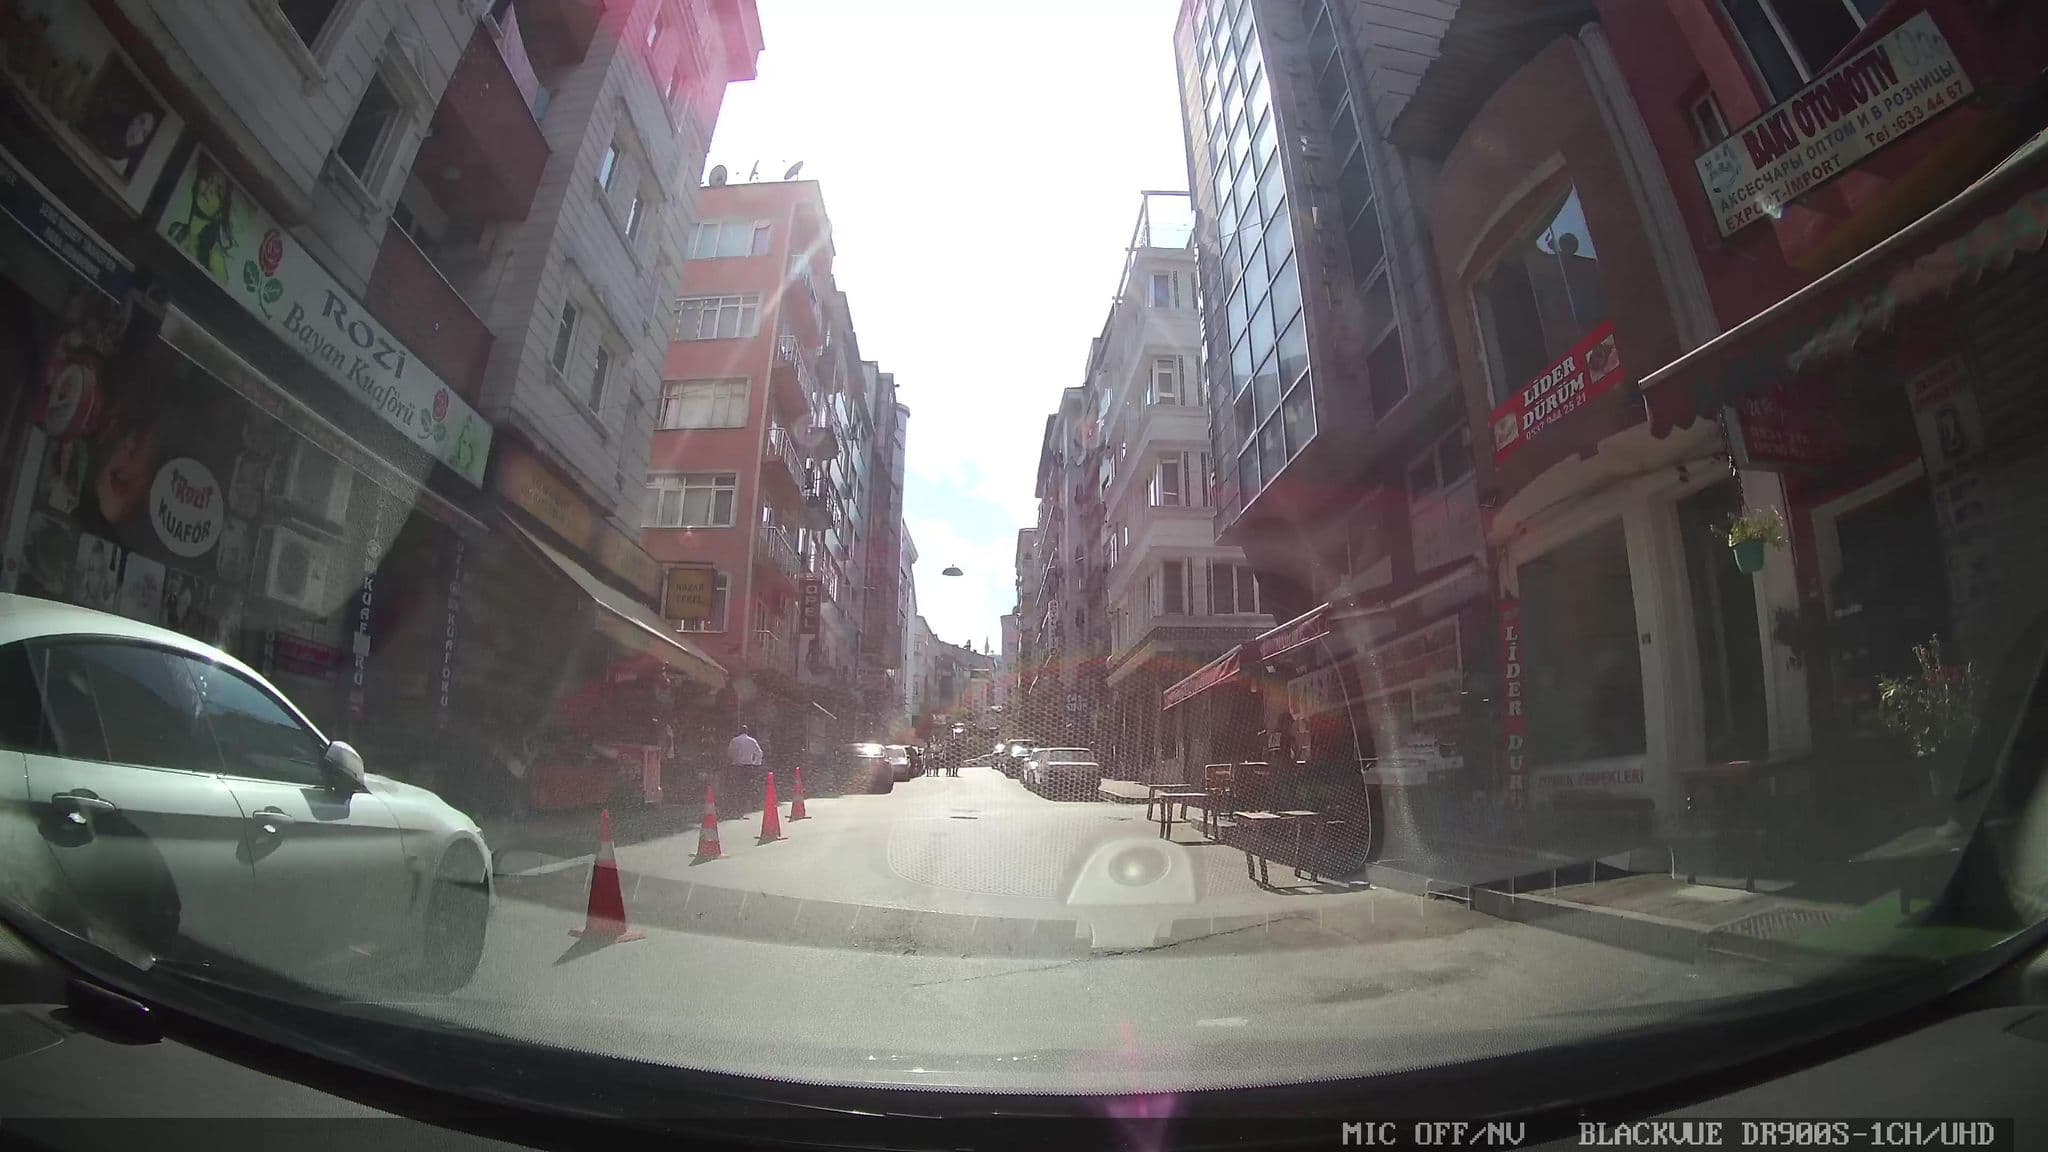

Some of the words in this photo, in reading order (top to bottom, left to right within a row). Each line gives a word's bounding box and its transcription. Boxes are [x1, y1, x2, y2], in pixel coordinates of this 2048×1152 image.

[1857, 113, 1869, 129] И
[1884, 60, 1957, 114] РОЗНИЦЫ
[283, 302, 346, 370] Bayan
[347, 354, 416, 427] Kuaförü
[322, 289, 407, 379] ROZİ
[1522, 355, 1577, 408] LİDER
[1522, 371, 1585, 431] DÜRÜM
[1504, 625, 1522, 717] LİDER
